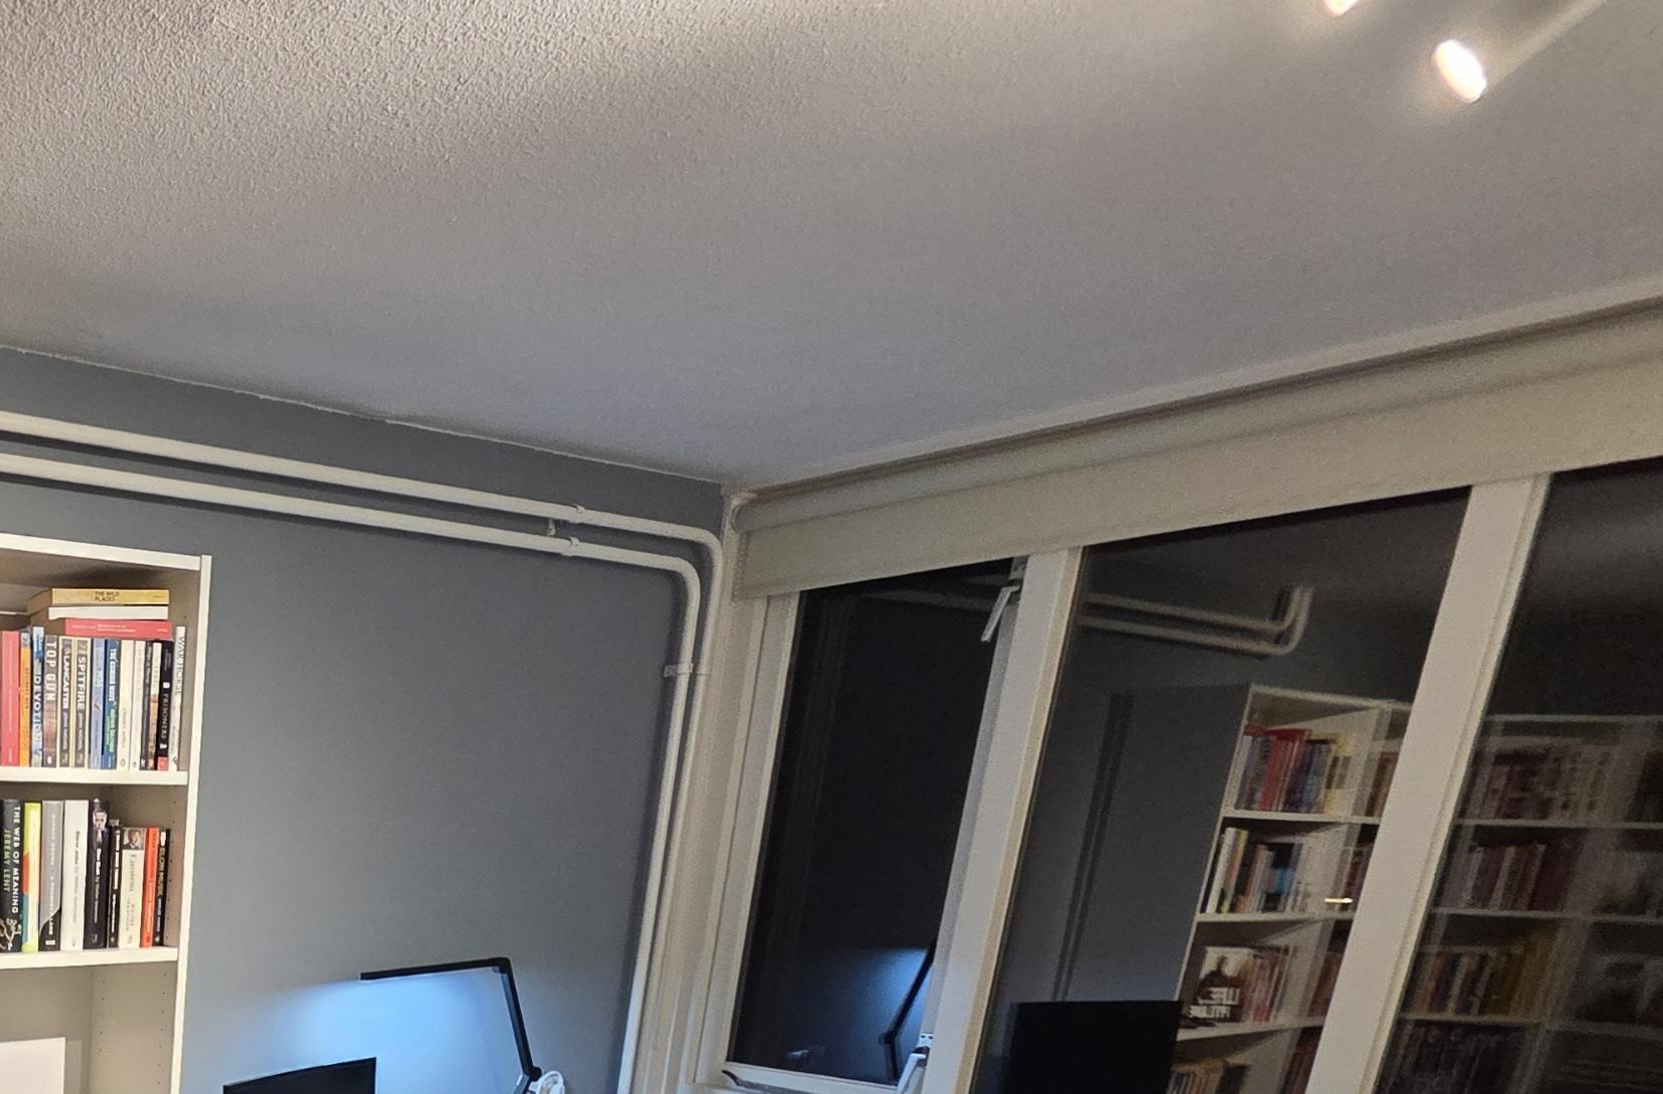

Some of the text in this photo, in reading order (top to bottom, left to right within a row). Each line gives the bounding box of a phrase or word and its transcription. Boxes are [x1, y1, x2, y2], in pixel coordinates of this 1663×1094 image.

[46, 641, 57, 702] TOP GUN
[61, 656, 72, 710] LANCASTER
[77, 656, 86, 710] SPITFIRE
[3, 829, 12, 892] JEREMY LENT
[11, 805, 21, 914] THE WEB OF MEANING
